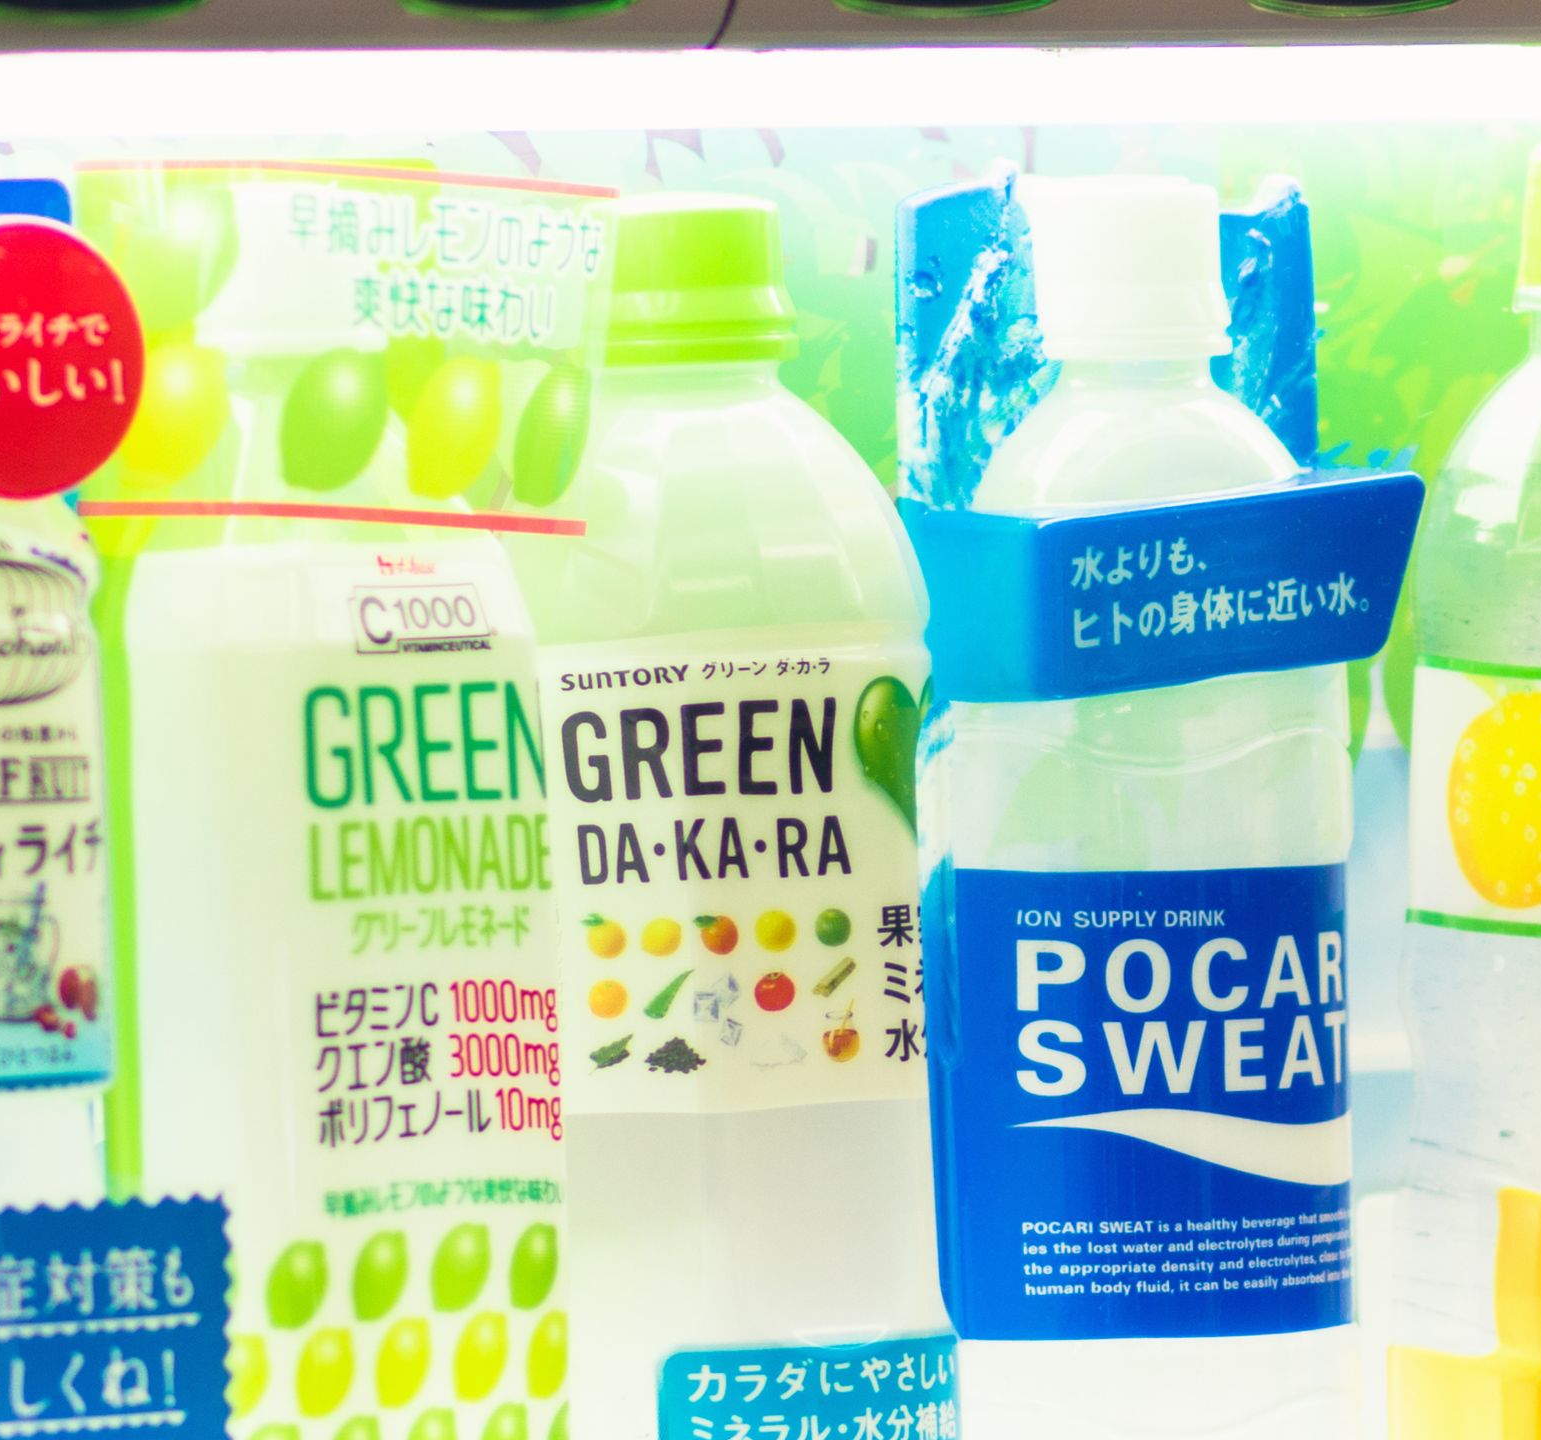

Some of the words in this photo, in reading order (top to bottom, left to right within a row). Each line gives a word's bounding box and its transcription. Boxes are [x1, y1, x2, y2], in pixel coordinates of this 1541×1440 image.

[1070, 537, 1208, 591] 水よりも、
[1072, 571, 1371, 650] ヒトの身体に近い水。
[560, 663, 690, 692] SUNTORY
[701, 660, 767, 681] グリーン
[304, 680, 548, 810] GREEN
[560, 695, 838, 804] GREEN
[308, 813, 552, 902] LEMONADE
[1015, 909, 1062, 928] ION
[1073, 909, 1157, 929] SUPPLY
[1163, 909, 1226, 928] DRINK
[1015, 930, 1345, 1014] POCAR
[315, 981, 439, 1039] ビタミンC
[449, 979, 558, 1033] 1000mg
[316, 1037, 433, 1093] クエン酸
[448, 1032, 561, 1087] 3000mg
[1015, 1014, 1348, 1098] SWEAT
[319, 1089, 492, 1148] ポリフェノール
[495, 1087, 563, 1142] 10mg
[1021, 1220, 1094, 1236] POCARI
[1099, 1219, 1155, 1234] SWEAT
[1186, 1218, 1239, 1233] healthy
[1241, 1214, 1296, 1230] beverage
[1298, 1212, 1318, 1225] that
[1052, 1240, 1082, 1255] the
[1087, 1240, 1119, 1255] lost
[1122, 1242, 1164, 1254] water
[1167, 1239, 1194, 1253] and
[1197, 1236, 1274, 1252] electrolytes
[1276, 1233, 1310, 1248] during
[1023, 1261, 1053, 1276] the
[1059, 1260, 1157, 1278] appropriate
[1161, 1259, 1214, 1274] density
[1219, 1257, 1245, 1271] and
[1024, 1282, 1085, 1296] human
[1090, 1280, 1131, 1297] body
[1136, 1278, 1176, 1294] fluid,
[1194, 1279, 1220, 1292] can
[1223, 1277, 1240, 1291] be
[1243, 1275, 1279, 1291] easily
[1281, 1271, 1327, 1287] absorbed
[686, 1352, 956, 1404] カラダにやさしい
